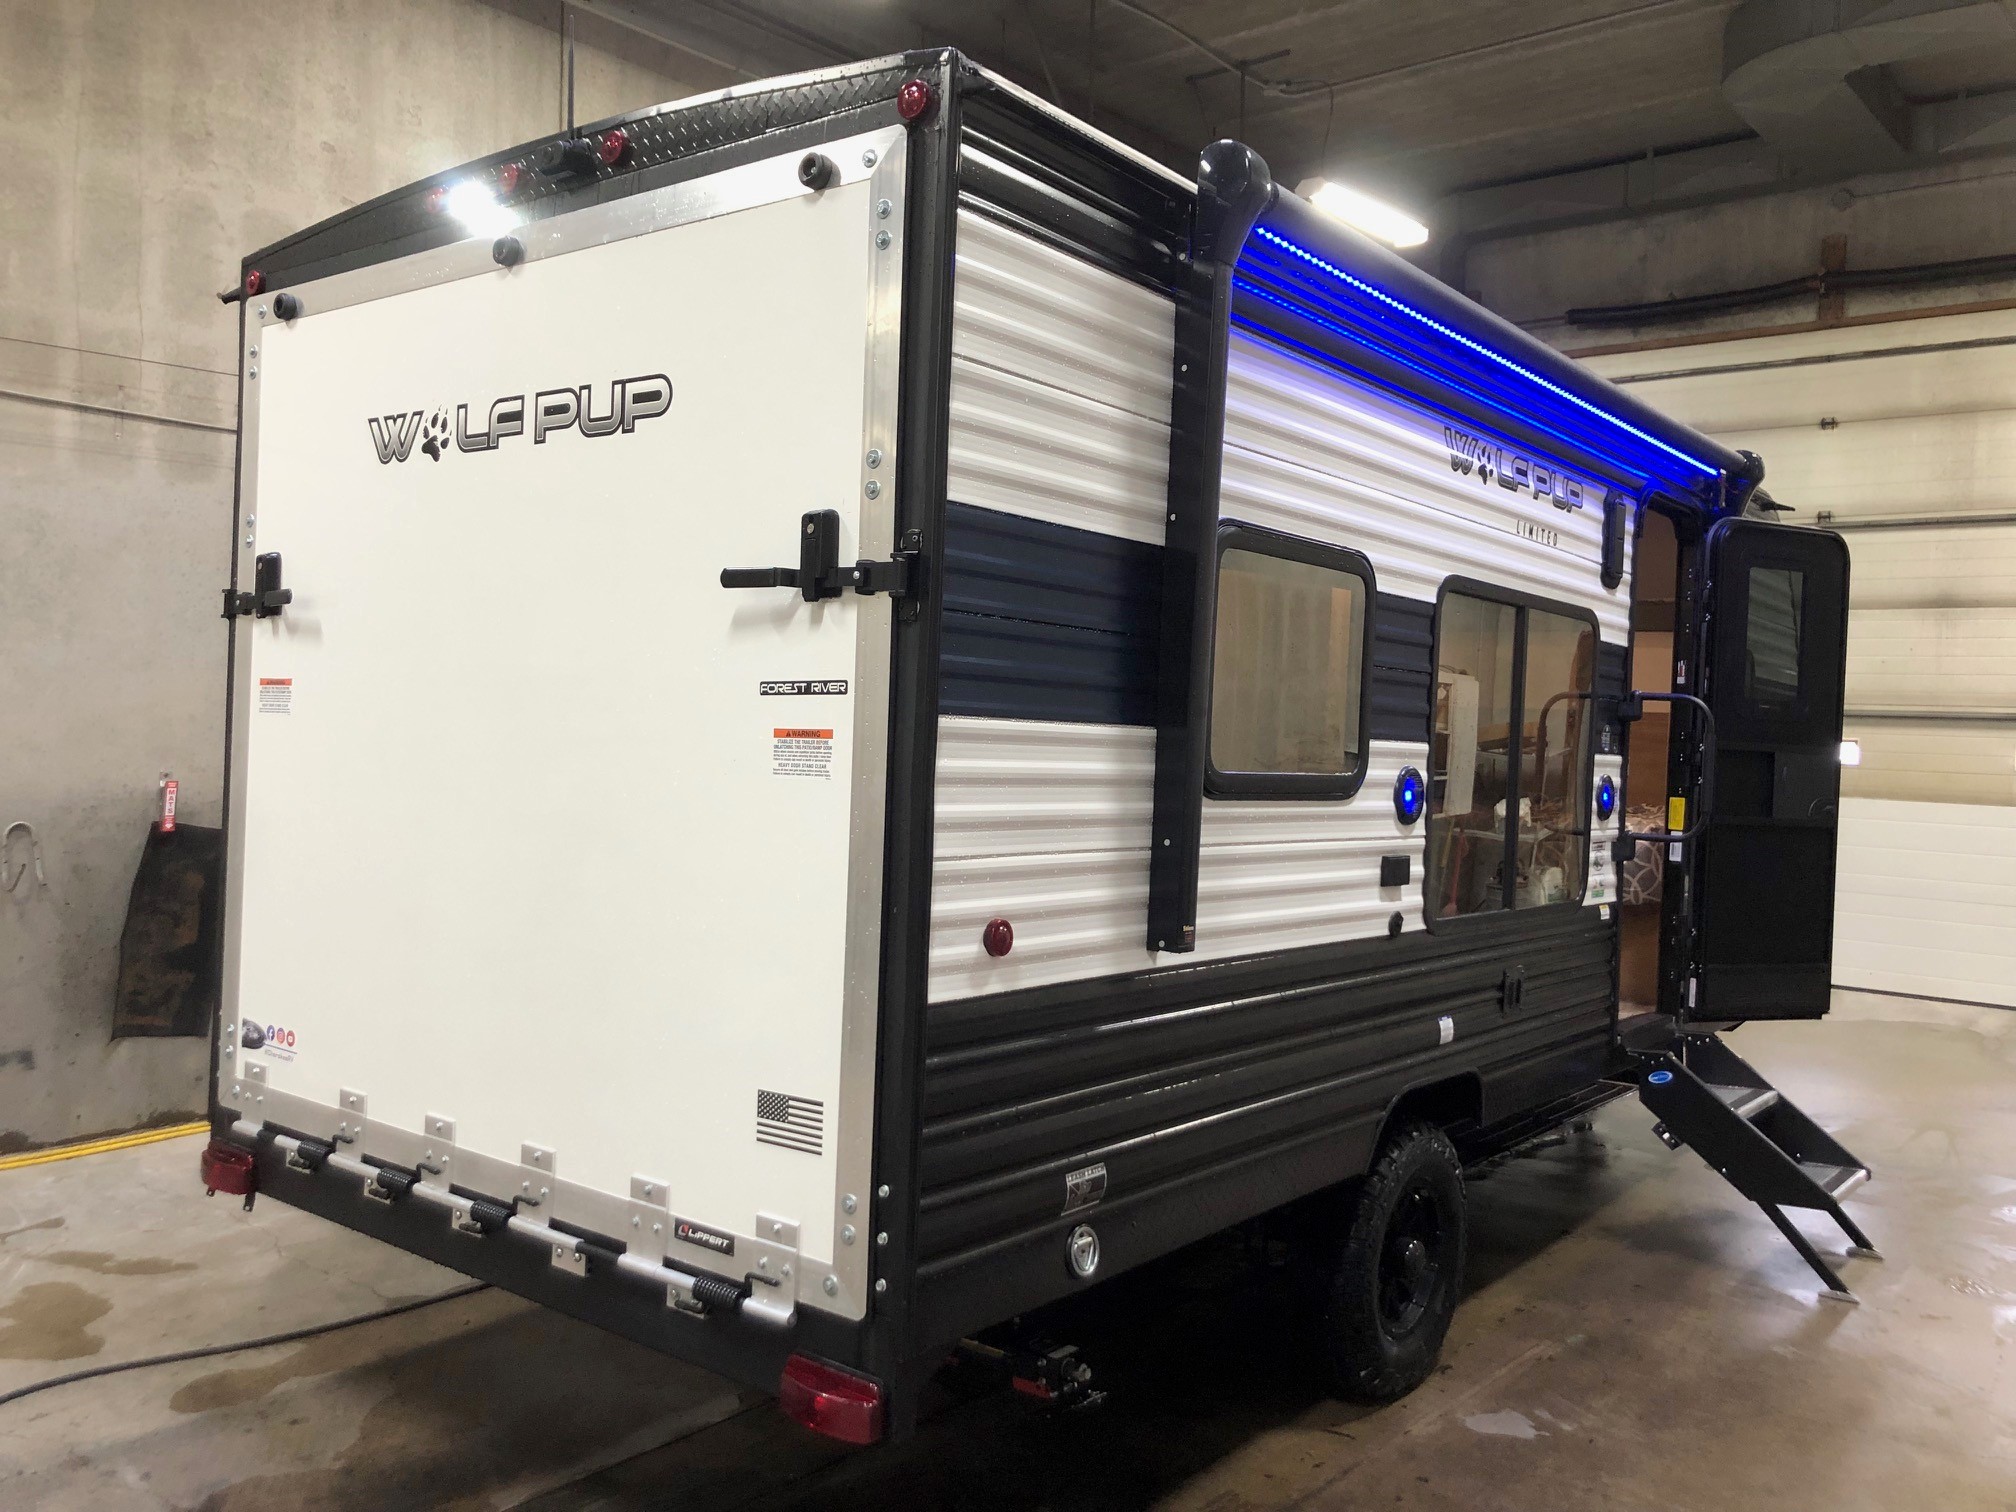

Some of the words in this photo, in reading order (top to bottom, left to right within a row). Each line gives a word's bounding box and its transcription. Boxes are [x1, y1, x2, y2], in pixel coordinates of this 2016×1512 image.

[534, 373, 673, 445] PUP
[1532, 464, 1584, 514] PUP
[1516, 519, 1558, 547] LIMITED
[760, 682, 808, 694] FOREST
[810, 681, 847, 693] RIVER
[792, 730, 821, 738] WARNING
[167, 789, 176, 814] MATS
[688, 1228, 729, 1247] LIPPERT
